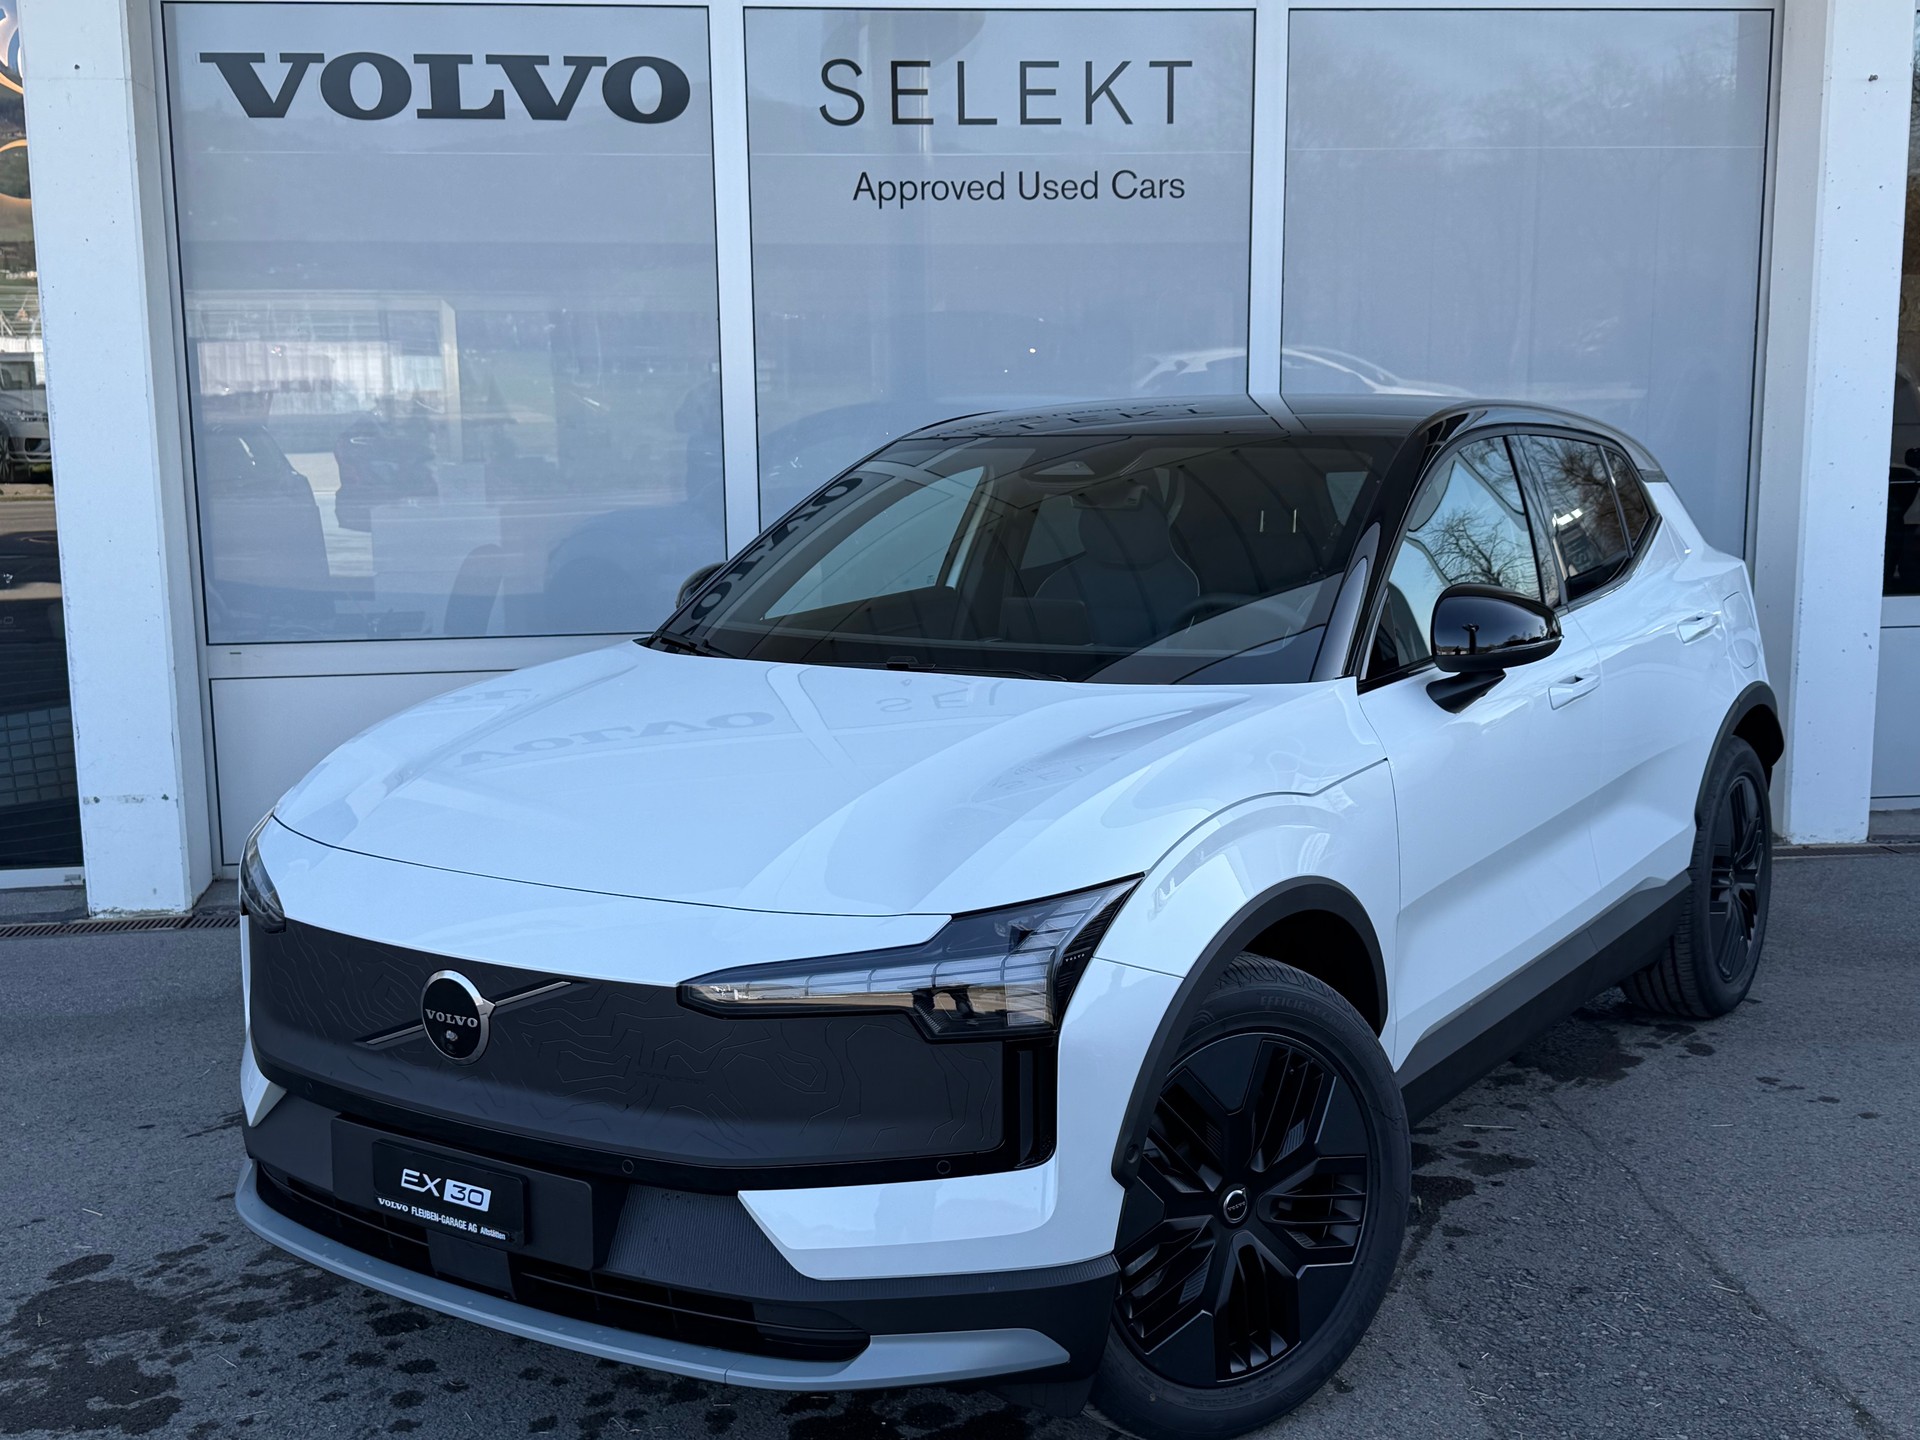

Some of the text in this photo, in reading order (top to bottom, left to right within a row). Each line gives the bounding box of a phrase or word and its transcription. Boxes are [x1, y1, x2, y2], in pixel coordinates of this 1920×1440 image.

[200, 51, 691, 124] VOLVO
[819, 58, 1193, 127] SELEKT
[853, 169, 1186, 209] Approved Used Cars
[425, 1008, 478, 1028] VOLVO
[377, 1197, 408, 1212] VOLVO
[411, 1206, 467, 1231] FLEUBEN-GARAGE
[468, 1222, 478, 1233] AG
